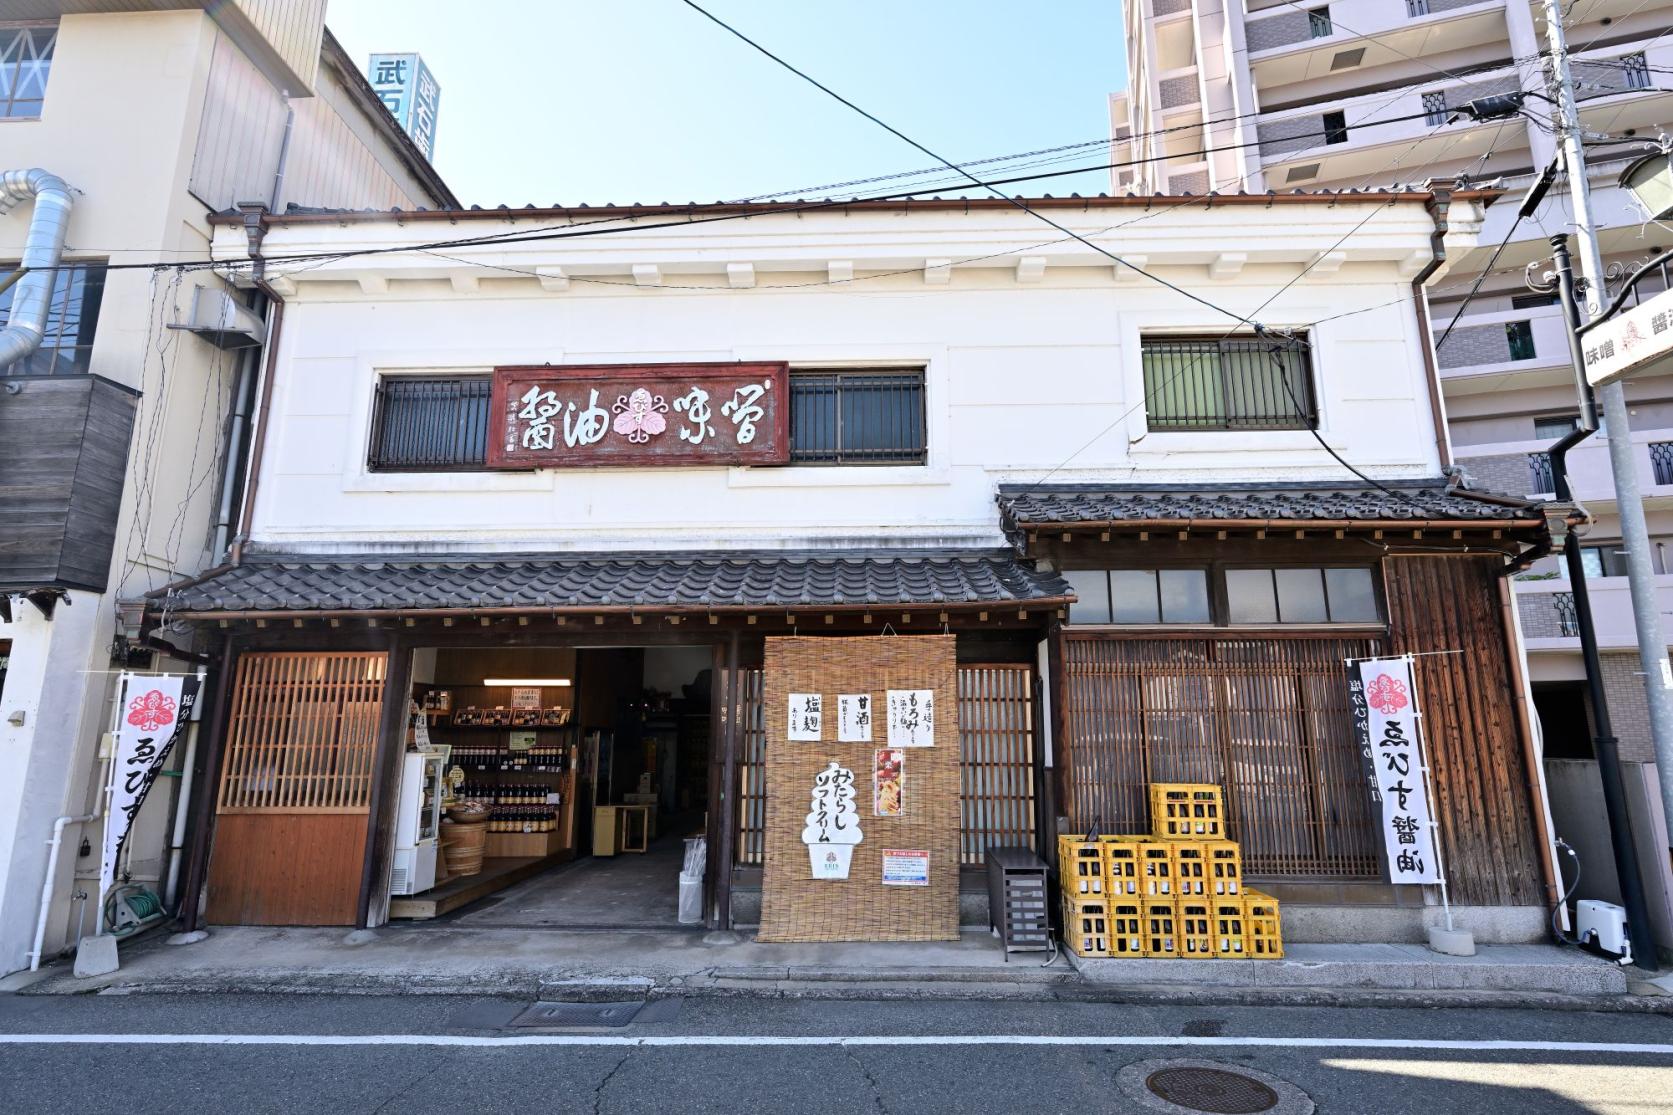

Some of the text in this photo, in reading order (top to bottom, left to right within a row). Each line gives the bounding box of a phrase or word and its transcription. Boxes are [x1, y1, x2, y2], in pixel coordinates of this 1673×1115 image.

[1586, 339, 1615, 366] 味噌
[856, 696, 869, 725] 甘酒
[906, 692, 919, 730] もろみ
[816, 775, 830, 842] ソフトクリーム
[832, 769, 851, 830] みたらし
